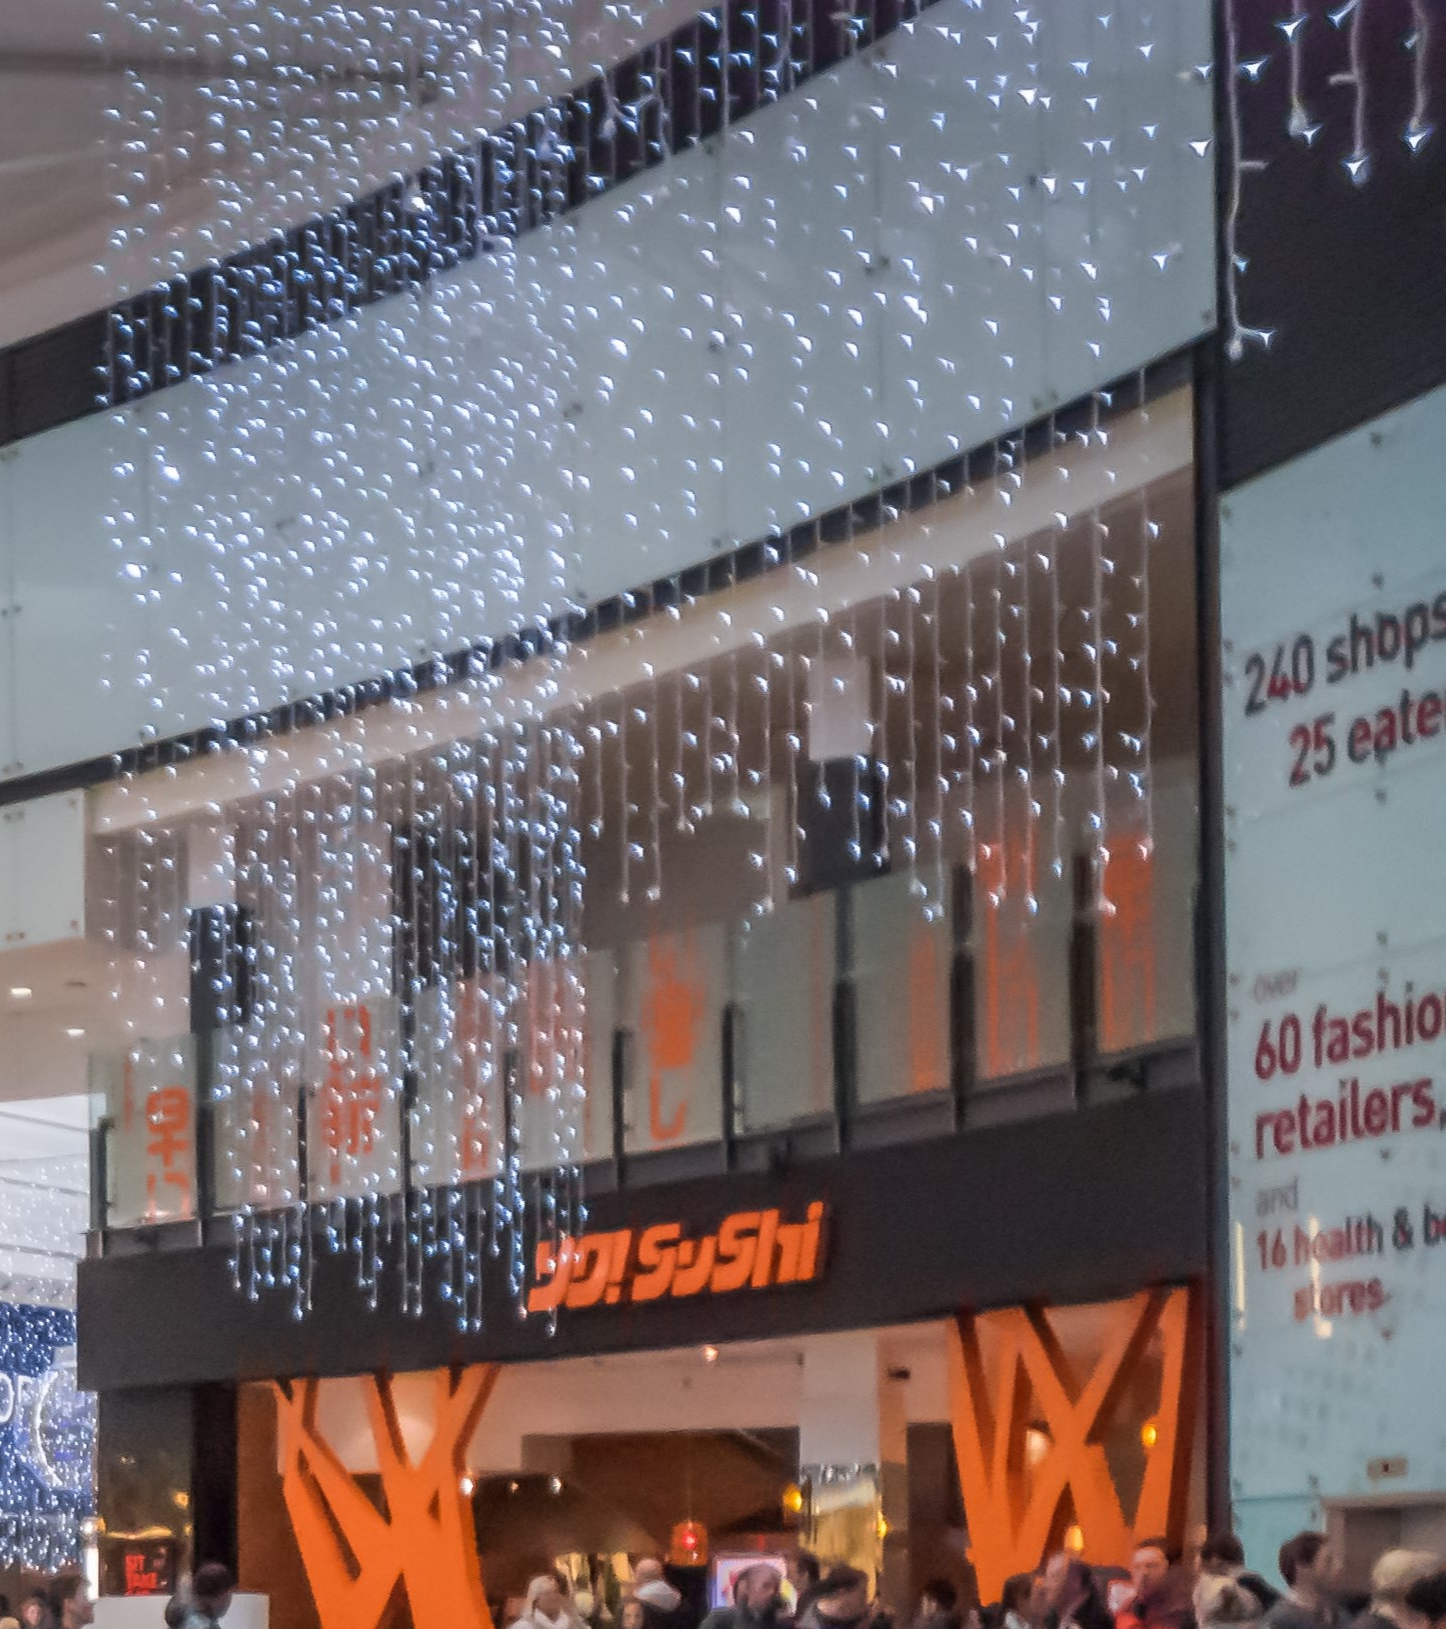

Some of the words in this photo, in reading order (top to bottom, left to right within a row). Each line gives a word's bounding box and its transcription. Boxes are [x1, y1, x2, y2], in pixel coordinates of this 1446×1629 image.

[1245, 633, 1314, 716] 240
[1289, 712, 1336, 787] 25
[1347, 689, 1446, 764] eate
[1255, 1013, 1301, 1080] 60
[1313, 981, 1446, 1068] fashio
[1258, 1227, 1287, 1271] 16
[1392, 1206, 1414, 1250] &
